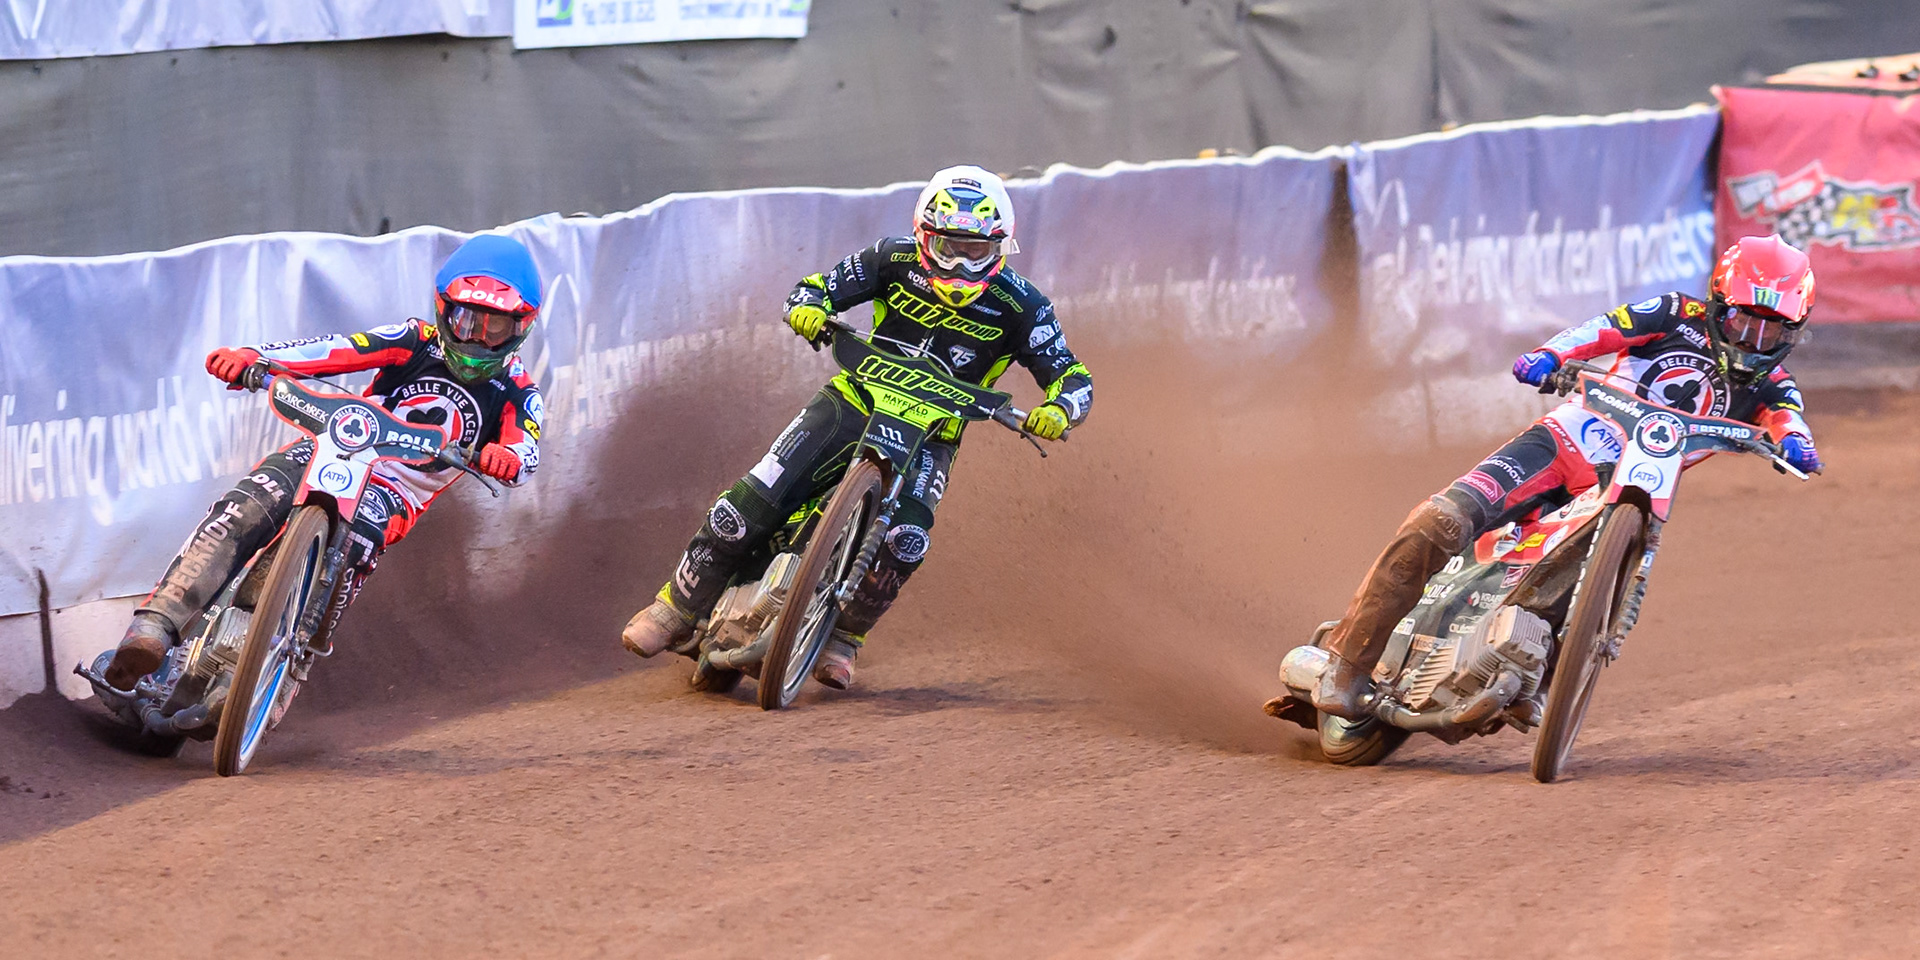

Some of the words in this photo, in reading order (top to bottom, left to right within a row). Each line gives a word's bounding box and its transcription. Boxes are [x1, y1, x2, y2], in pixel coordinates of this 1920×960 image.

[458, 289, 505, 308] BOLL
[1676, 323, 1707, 348] ROWE
[1658, 356, 1698, 370] BELLE
[275, 388, 330, 424] GARCAREK
[402, 382, 441, 398] BELLE
[446, 387, 469, 410] VUE
[463, 412, 476, 443] ACES
[244, 473, 286, 504] OLL
[323, 470, 347, 485] ATPI
[1633, 470, 1658, 485] ATPI
[160, 500, 244, 602] BECKHOFF
